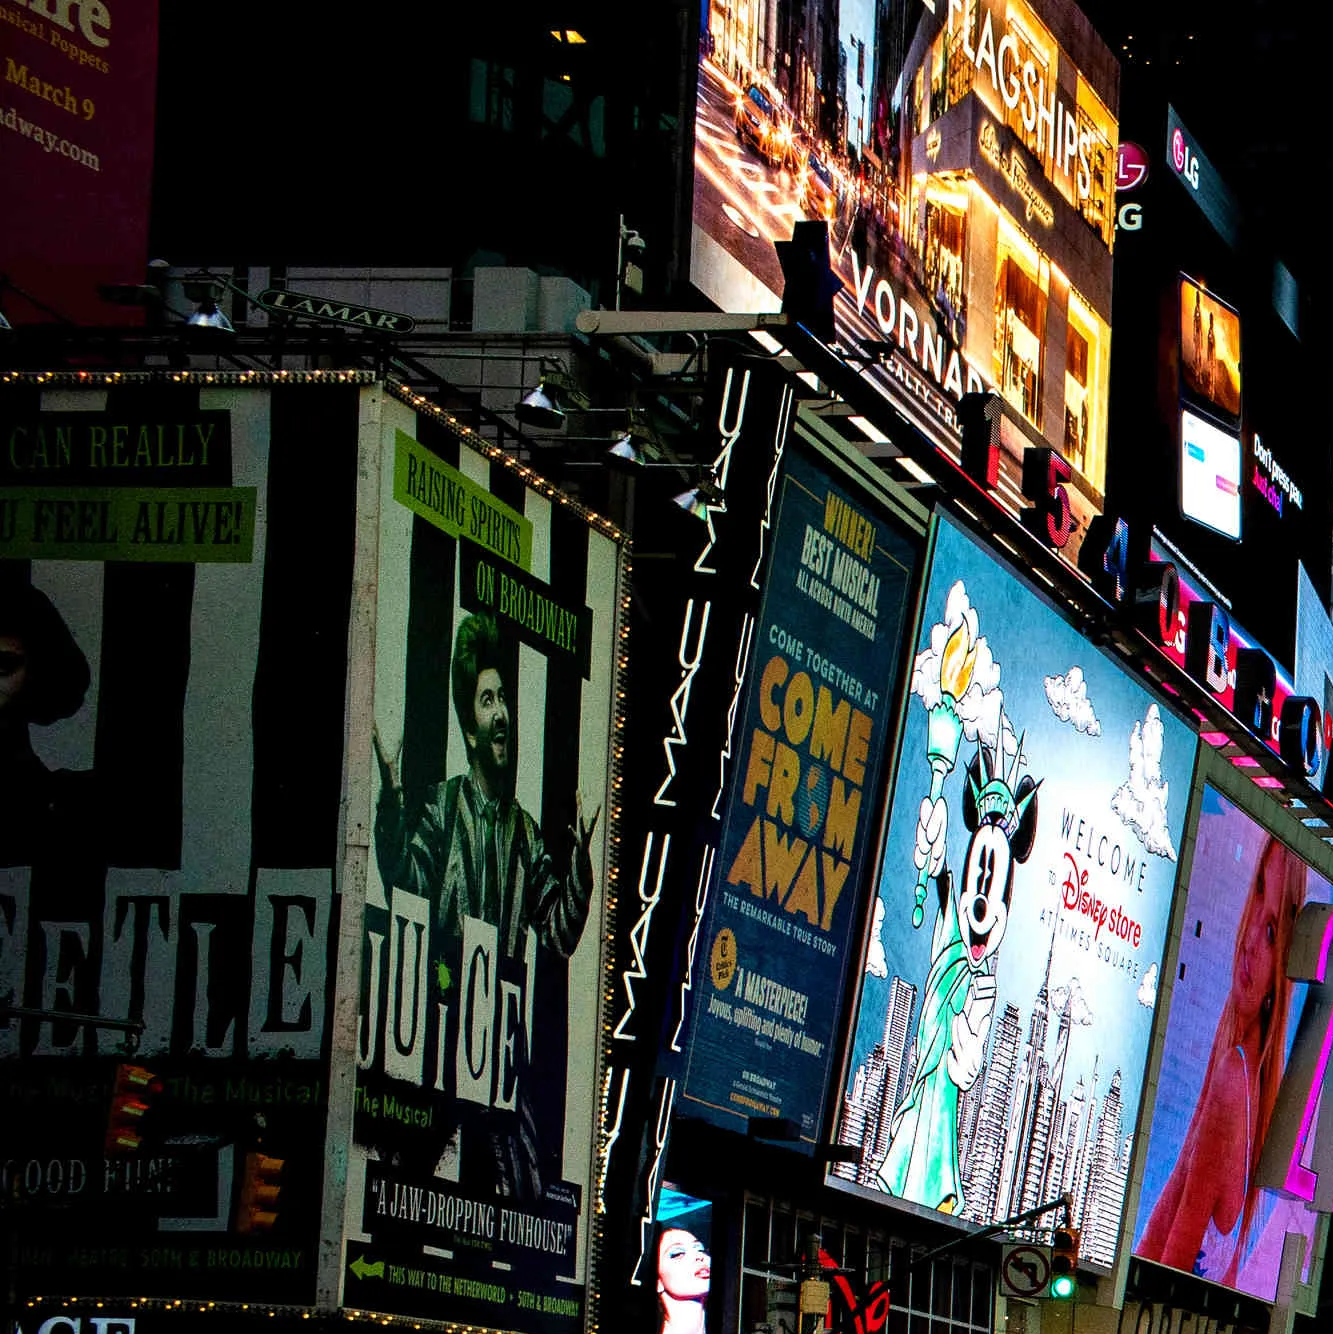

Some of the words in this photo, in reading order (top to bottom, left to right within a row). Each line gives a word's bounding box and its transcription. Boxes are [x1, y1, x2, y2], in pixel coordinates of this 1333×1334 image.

[5, 56, 78, 116] March
[82, 98, 96, 121] 9
[948, 0, 1093, 200] FLAGSHIPS
[1184, 144, 1200, 190] LG
[273, 293, 399, 329] LAMAR
[9, 424, 73, 469] CAN
[88, 421, 217, 468] REALLY
[33, 502, 119, 544] FEEL
[133, 498, 243, 545] ALIVE!
[406, 452, 466, 530] RAISING
[470, 503, 523, 565] SPIRITS
[825, 490, 878, 565] WINNER!
[801, 523, 831, 578] BEST
[831, 549, 882, 615] MUSICAL
[475, 560, 497, 602] ON
[499, 567, 579, 655] BROADWAY!
[769, 624, 803, 660] COME
[805, 647, 863, 700] TOGETHER
[864, 686, 879, 707] AT
[758, 655, 874, 786] COME
[726, 815, 850, 933] AWAY
[1061, 807, 1147, 893] WELCOME
[723, 891, 739, 909] THE
[739, 898, 792, 936] REMARKABLE
[792, 925, 812, 944] TRUE
[812, 933, 837, 957] STORY
[1059, 918, 1091, 951] TIMES
[1097, 942, 1139, 980] SQUARE
[1108, 905, 1142, 948] store
[356, 911, 523, 1113] JUICE
[745, 972, 809, 1025] MASTERPIECE!
[355, 1087, 379, 1120] The
[382, 1094, 434, 1128] Musical
[390, 1182, 496, 1239] JAW-DROPPING
[499, 1207, 574, 1257] FUNHOUSE!"
[388, 1263, 405, 1286] THIS
[407, 1266, 425, 1290] WAY
[426, 1271, 437, 1290] TO
[438, 1272, 452, 1293] THE
[453, 1276, 507, 1304] NETHERWORLD
